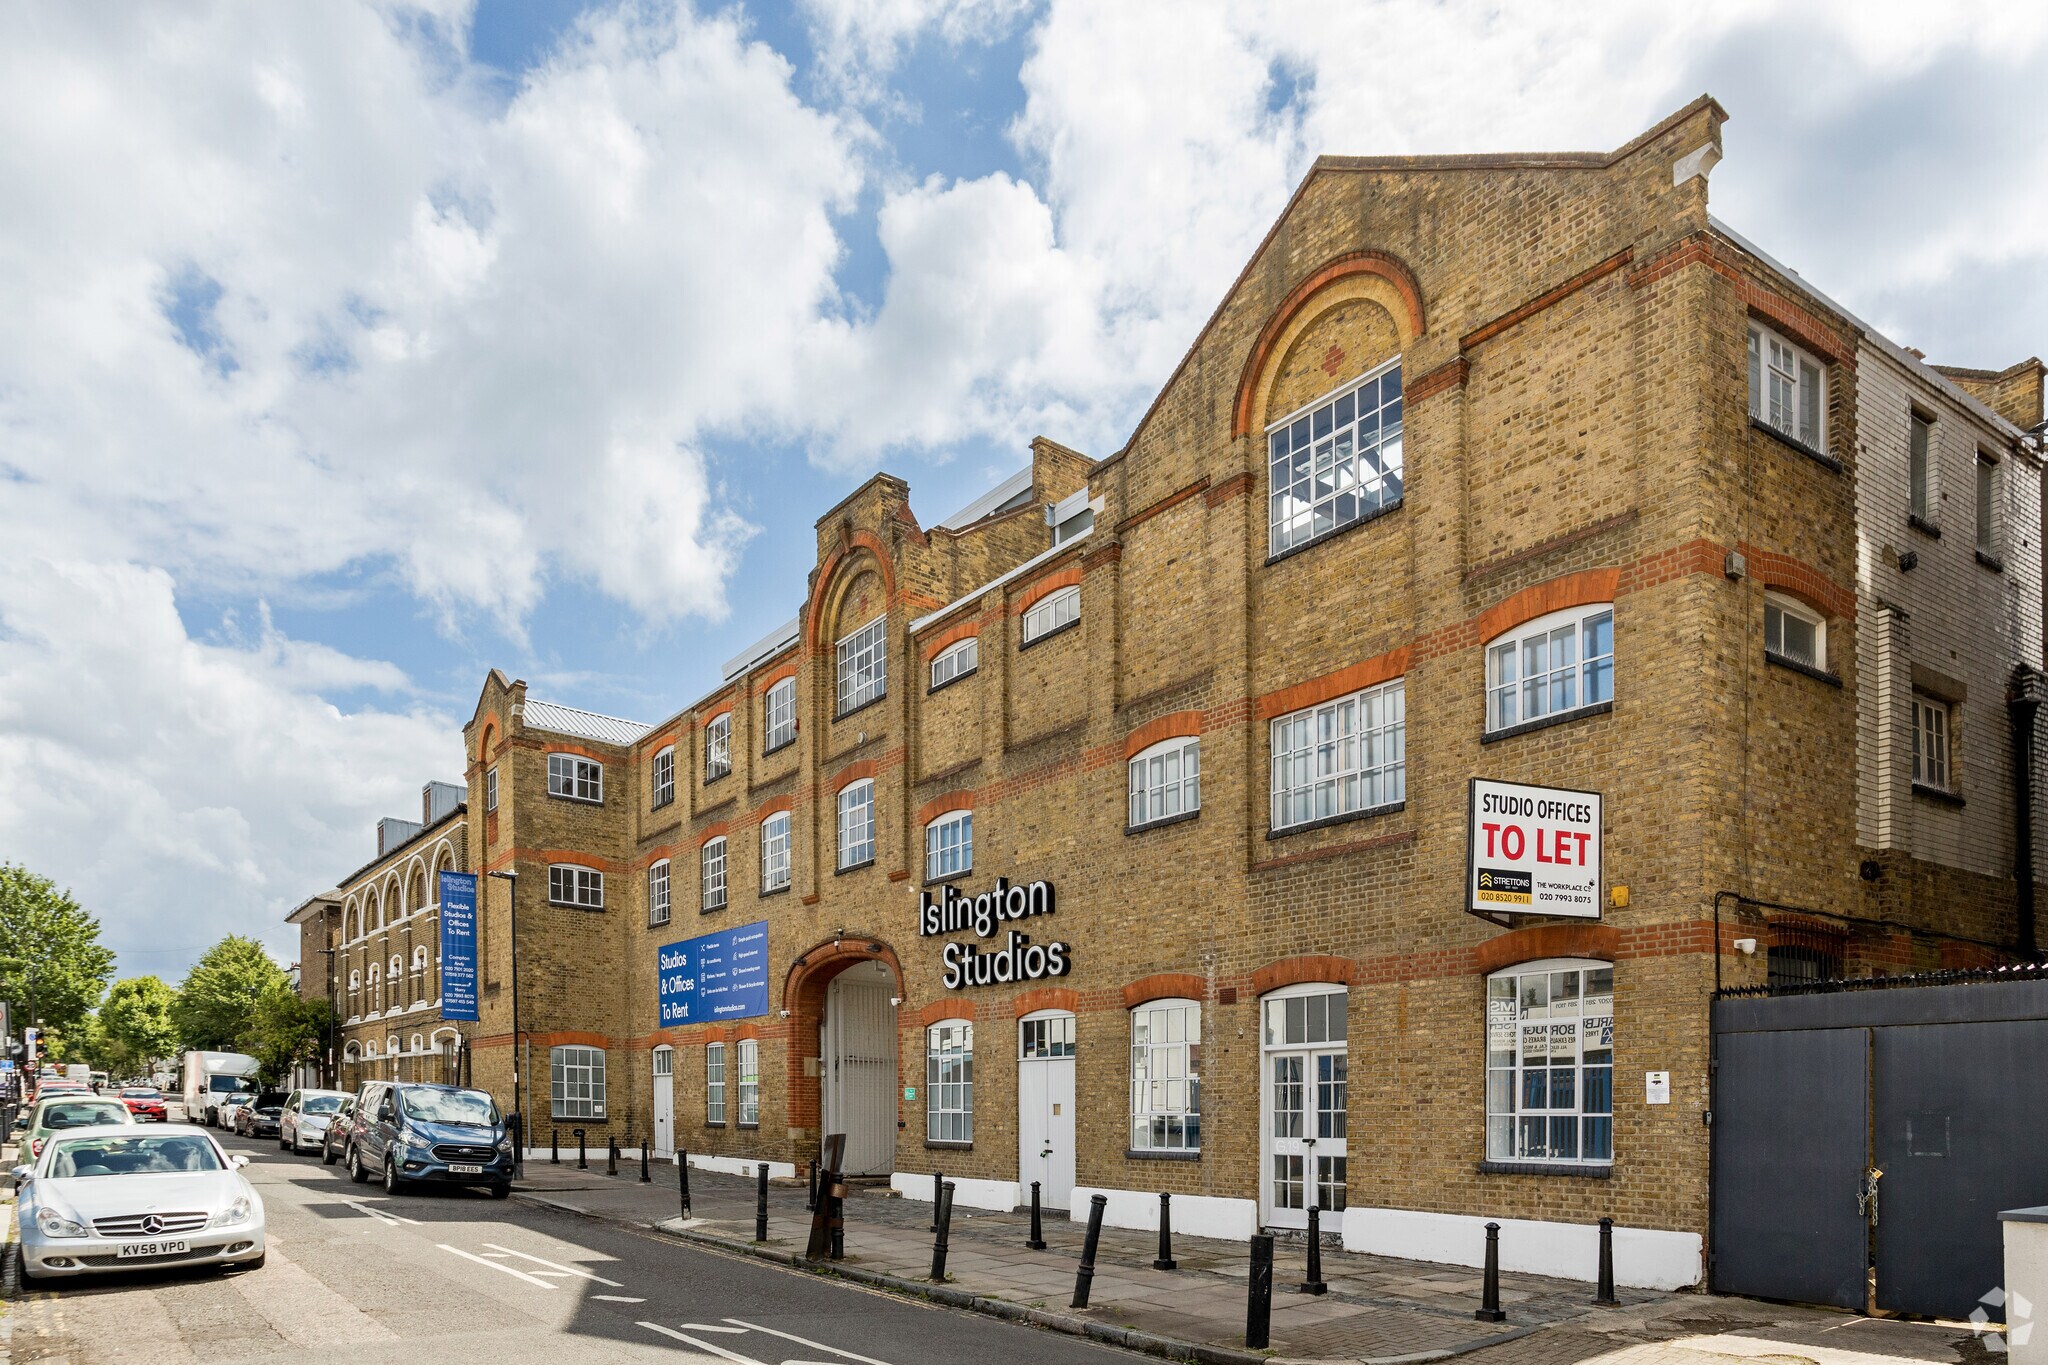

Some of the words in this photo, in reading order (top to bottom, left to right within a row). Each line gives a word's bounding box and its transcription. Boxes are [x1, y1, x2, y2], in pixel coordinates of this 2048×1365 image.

[1483, 793, 1533, 817] STUDIO
[1537, 800, 1591, 823] OFFICES
[1482, 822, 1525, 861] TO
[1536, 828, 1591, 867] LET
[441, 874, 472, 886] Islington
[1493, 876, 1530, 887] STRETTONS
[447, 883, 475, 893] Studios
[1537, 881, 1547, 889] THE
[1548, 882, 1583, 892] WORKPLACE
[1481, 892, 1494, 901] 020
[1495, 893, 1511, 902] 8520
[1513, 895, 1529, 904] 9911
[1539, 892, 1553, 901] 020
[1554, 894, 1572, 903] 7993
[1574, 895, 1592, 904] 8075
[447, 902, 470, 910] Flexible
[920, 877, 1055, 938] Islington
[444, 911, 466, 919] Studios
[448, 919, 469, 927] Offices
[661, 950, 687, 970] Studios
[942, 930, 1071, 990] Studios
[661, 978, 668, 995] &
[669, 975, 694, 993] Offices
[662, 1004, 671, 1020] To
[672, 1002, 688, 1018] Rent
[1276, 1140, 1299, 1153] G.19
[123, 1244, 157, 1255] KV58
[161, 1241, 185, 1252] VPO
